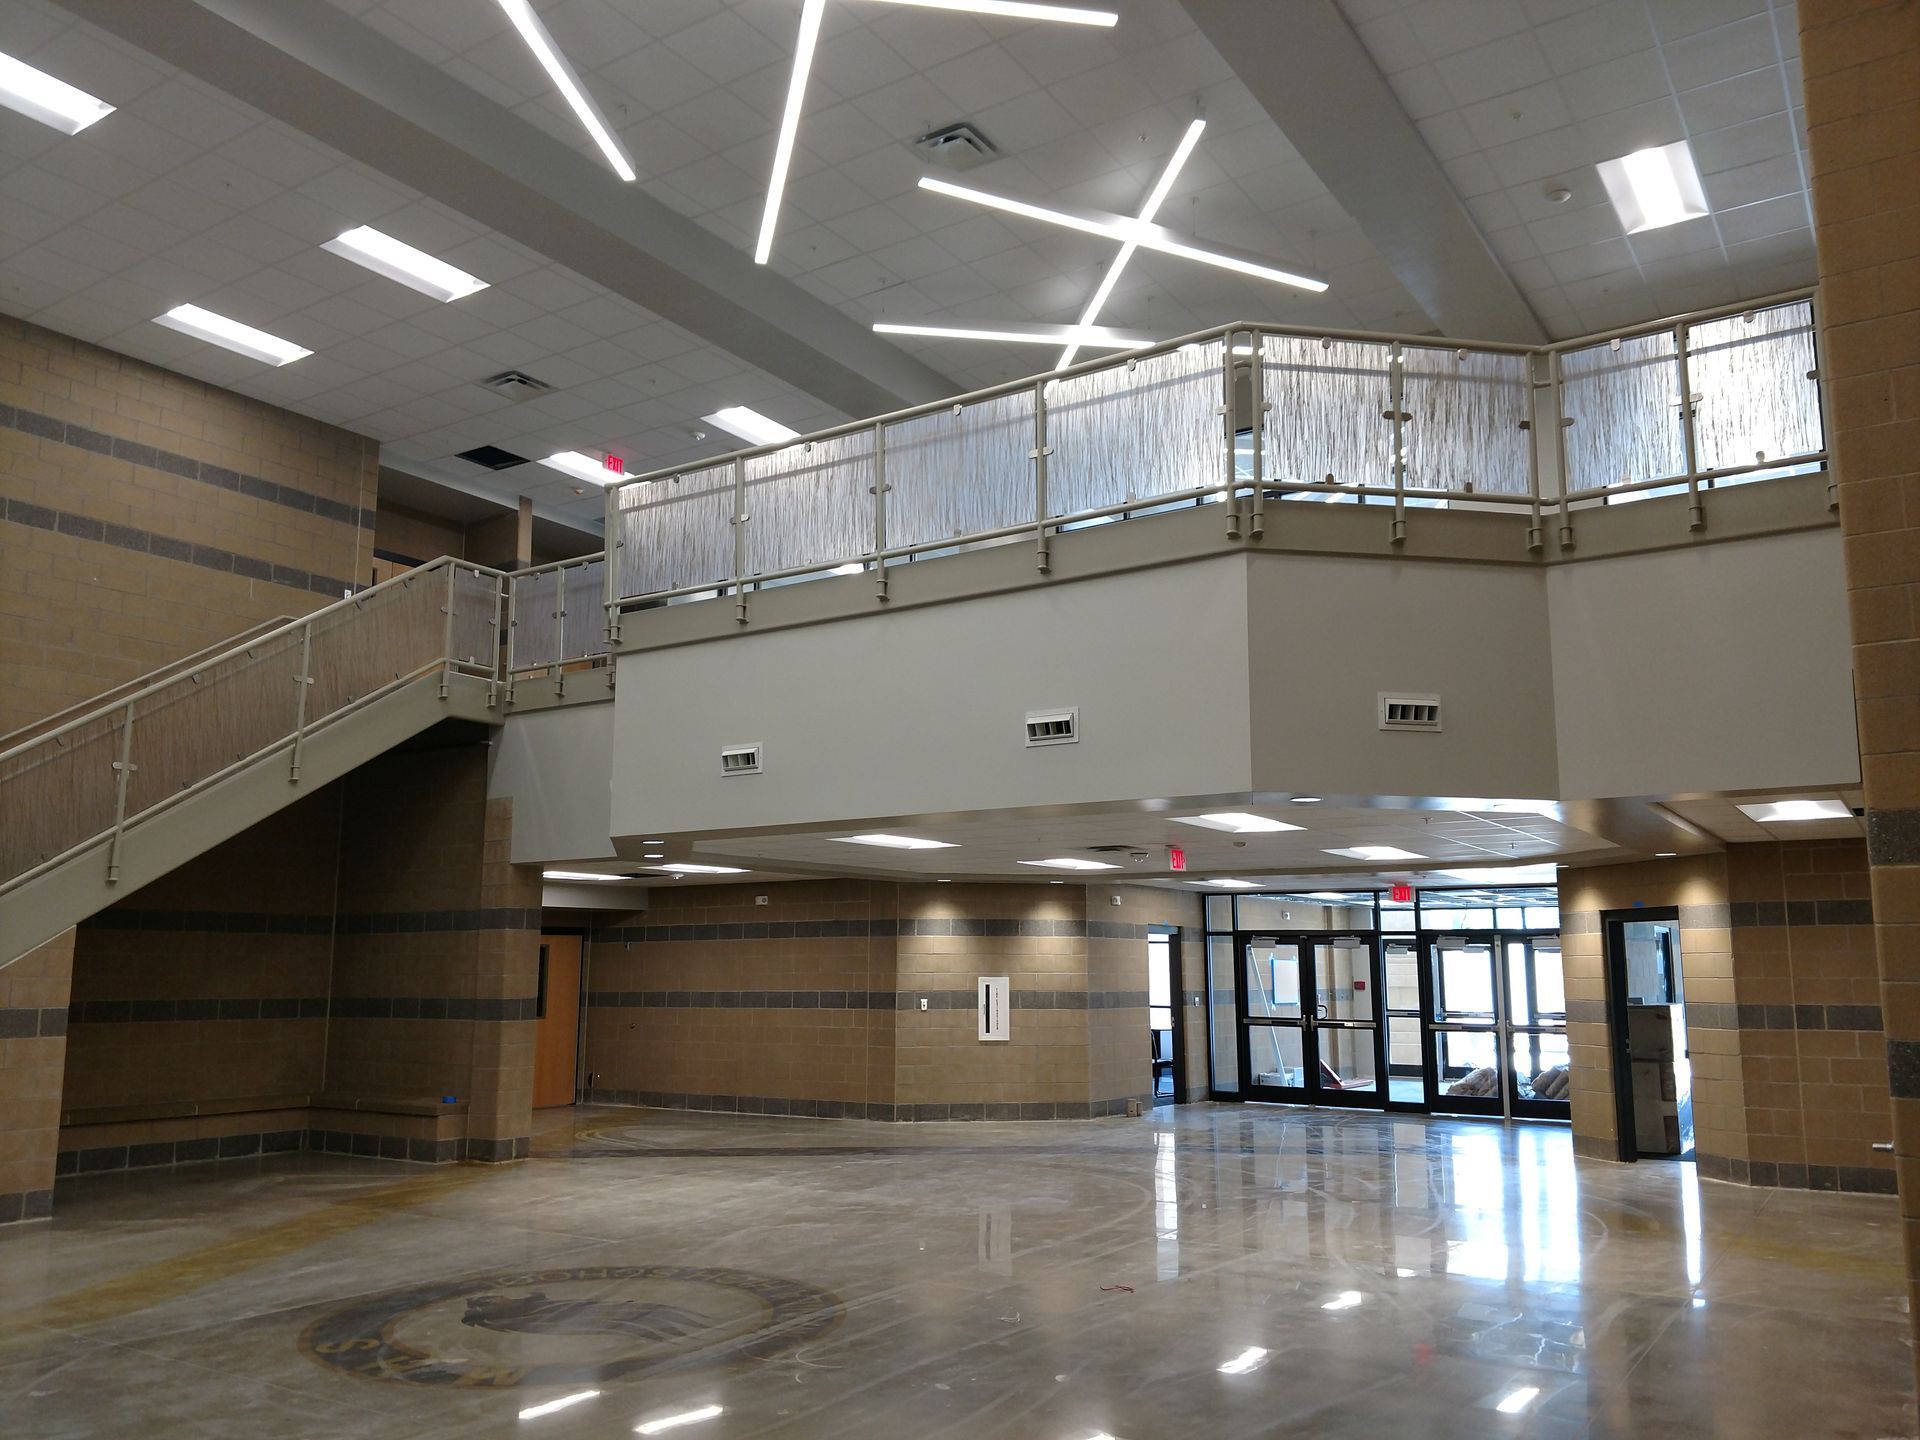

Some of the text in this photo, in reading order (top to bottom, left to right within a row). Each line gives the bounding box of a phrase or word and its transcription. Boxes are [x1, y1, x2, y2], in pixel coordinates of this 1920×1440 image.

[607, 455, 623, 473] EXIT
[1172, 850, 1184, 870] EXIT
[1393, 887, 1411, 901] EXIT
